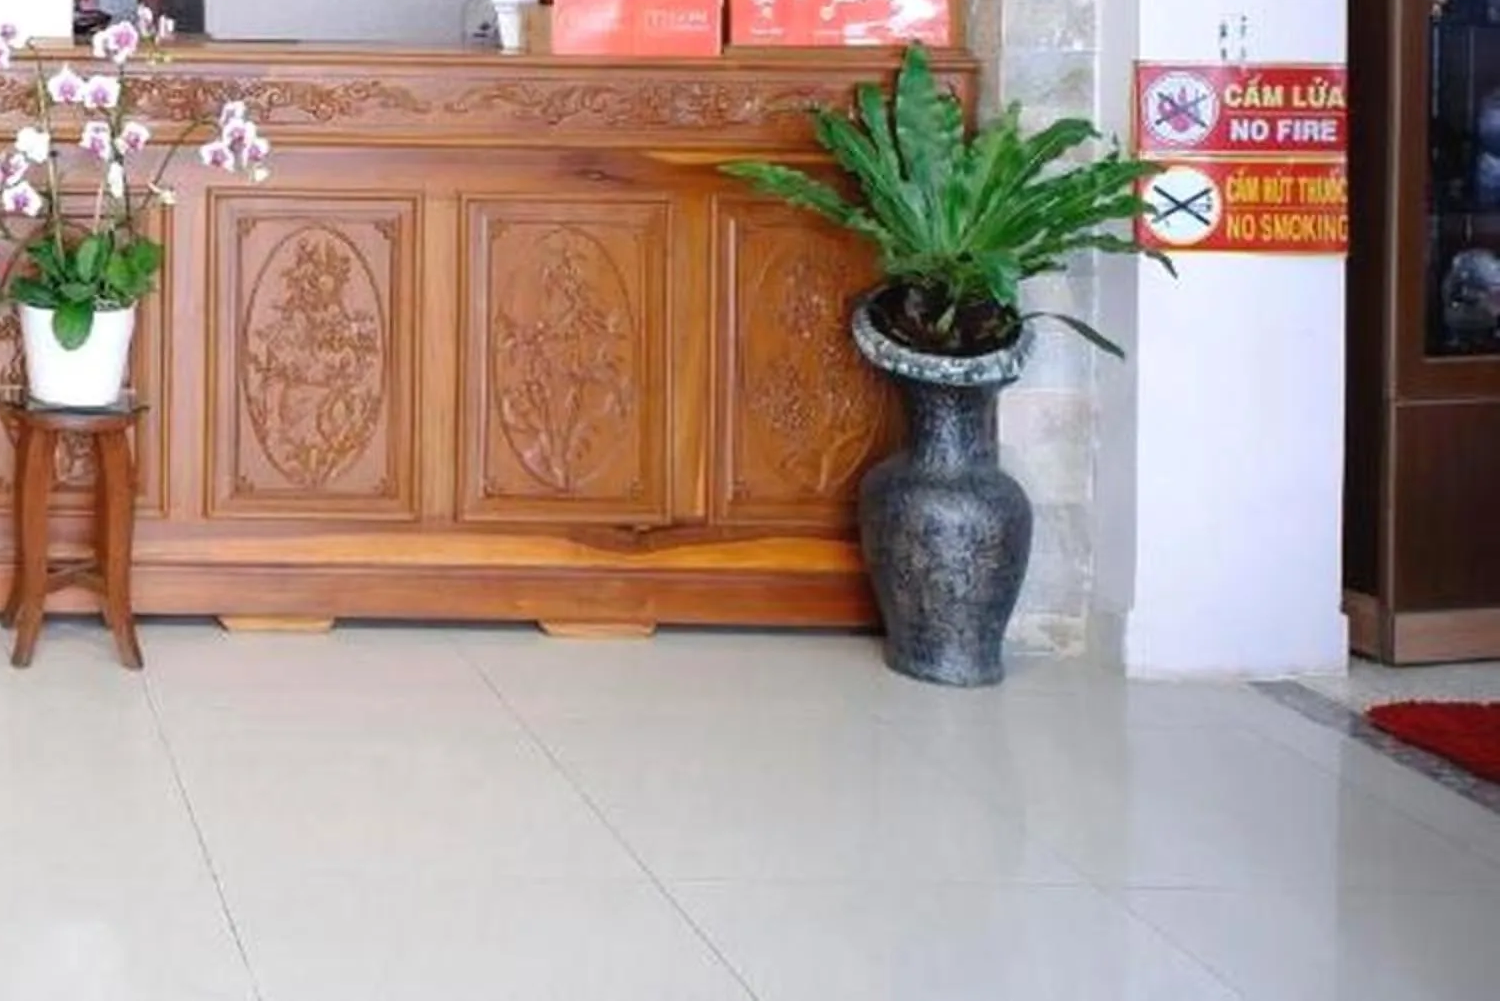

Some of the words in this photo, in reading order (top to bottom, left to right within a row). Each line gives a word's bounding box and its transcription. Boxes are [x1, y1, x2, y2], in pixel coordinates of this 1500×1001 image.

[1224, 74, 1284, 108] CẤM
[1230, 119, 1270, 142] NO
[1277, 119, 1339, 142] FIRE
[1226, 214, 1256, 241] NO
